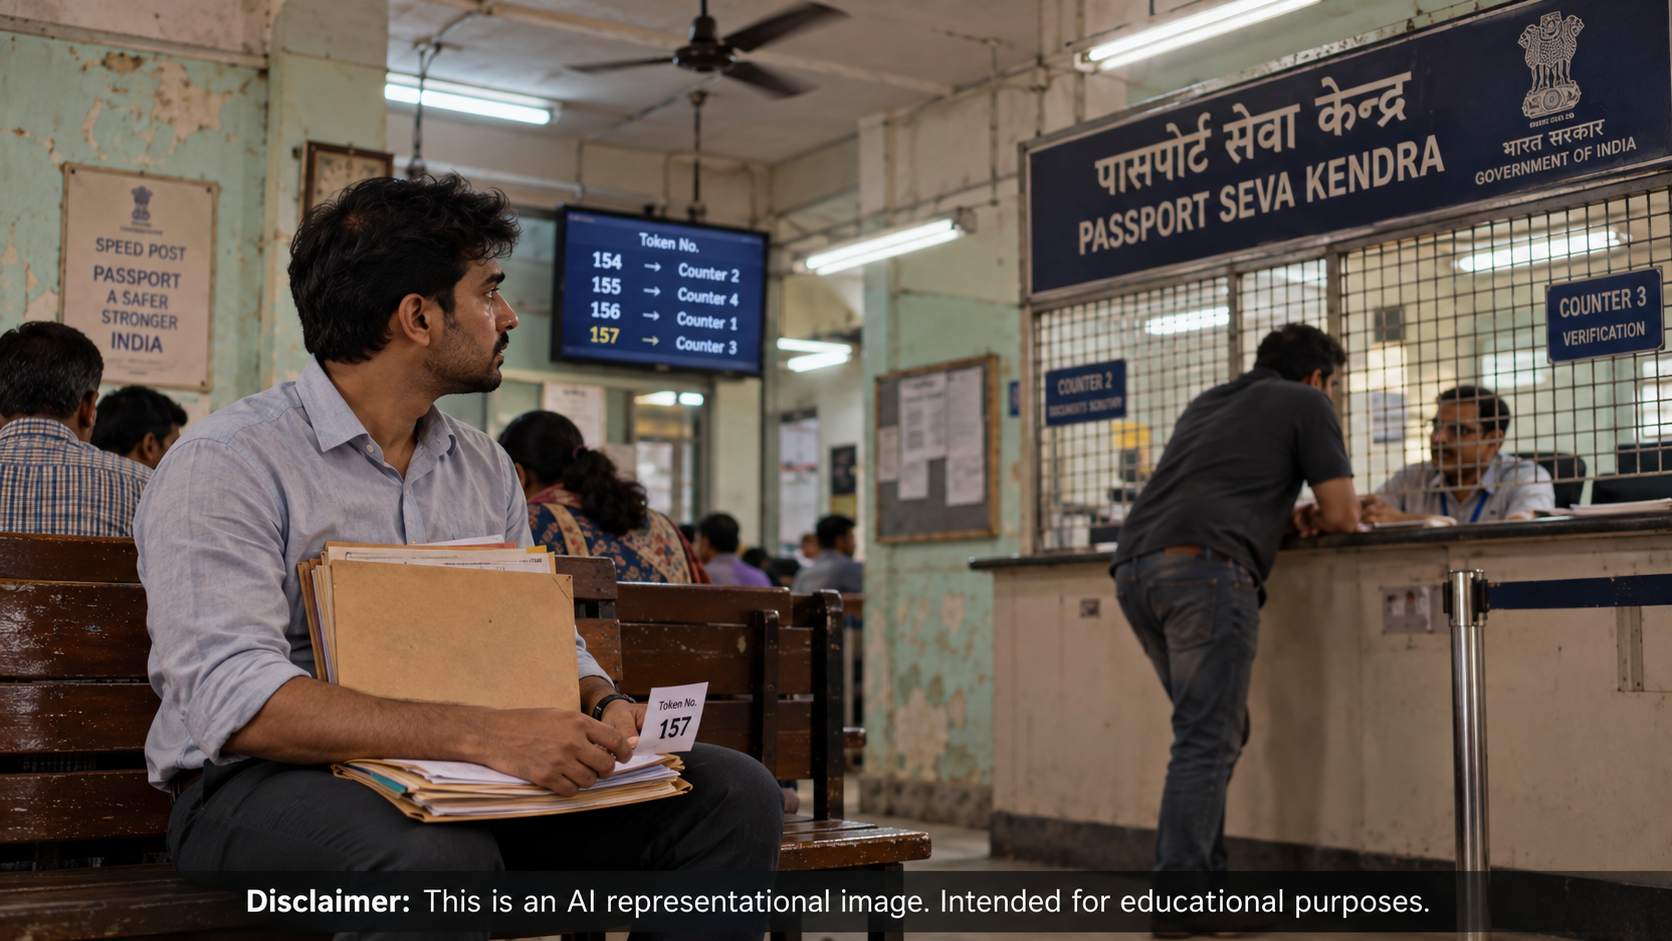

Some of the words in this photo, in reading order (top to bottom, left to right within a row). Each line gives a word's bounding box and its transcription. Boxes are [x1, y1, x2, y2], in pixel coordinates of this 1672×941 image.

[1095, 112, 1212, 196] पासपोर्ट
[1223, 102, 1301, 165] सेवा
[1314, 71, 1412, 136] केन्द्र
[1502, 134, 1543, 157] भारत
[1548, 119, 1605, 147] सरकार
[1475, 152, 1569, 186] GOVERNMENT
[1573, 146, 1593, 163] OF
[1597, 136, 1637, 158] INDIA
[1078, 191, 1209, 255] PASSPORT
[1219, 171, 1296, 223] SEVA
[1305, 134, 1446, 203] KENDRA
[95, 237, 143, 257] SPEED
[148, 243, 187, 261] POST
[639, 232, 676, 250] Token
[679, 238, 700, 253] No.
[93, 265, 182, 289] PASSPORT
[592, 251, 622, 270] 154
[678, 262, 727, 281] Counter
[731, 268, 740, 283] 2
[106, 289, 117, 304] A
[122, 290, 168, 310] SAFER
[592, 276, 621, 295] 155
[677, 287, 727, 306] Counter
[729, 293, 739, 307] 4
[1559, 288, 1632, 318] COUNTER
[1636, 286, 1647, 307] 3
[101, 309, 178, 330] STRONGER
[590, 301, 621, 320] 156
[676, 311, 725, 330] Counter
[730, 317, 738, 331] 1
[111, 331, 163, 353] INDIA
[590, 326, 620, 344] 157
[675, 336, 725, 354] Counter
[728, 340, 738, 355] 3
[1562, 320, 1645, 347] VERIFICATION
[1057, 373, 1103, 396] COUNTER
[1105, 371, 1113, 389] 2
[659, 699, 683, 711] Token
[684, 697, 697, 708] No.
[659, 715, 692, 740] 157
